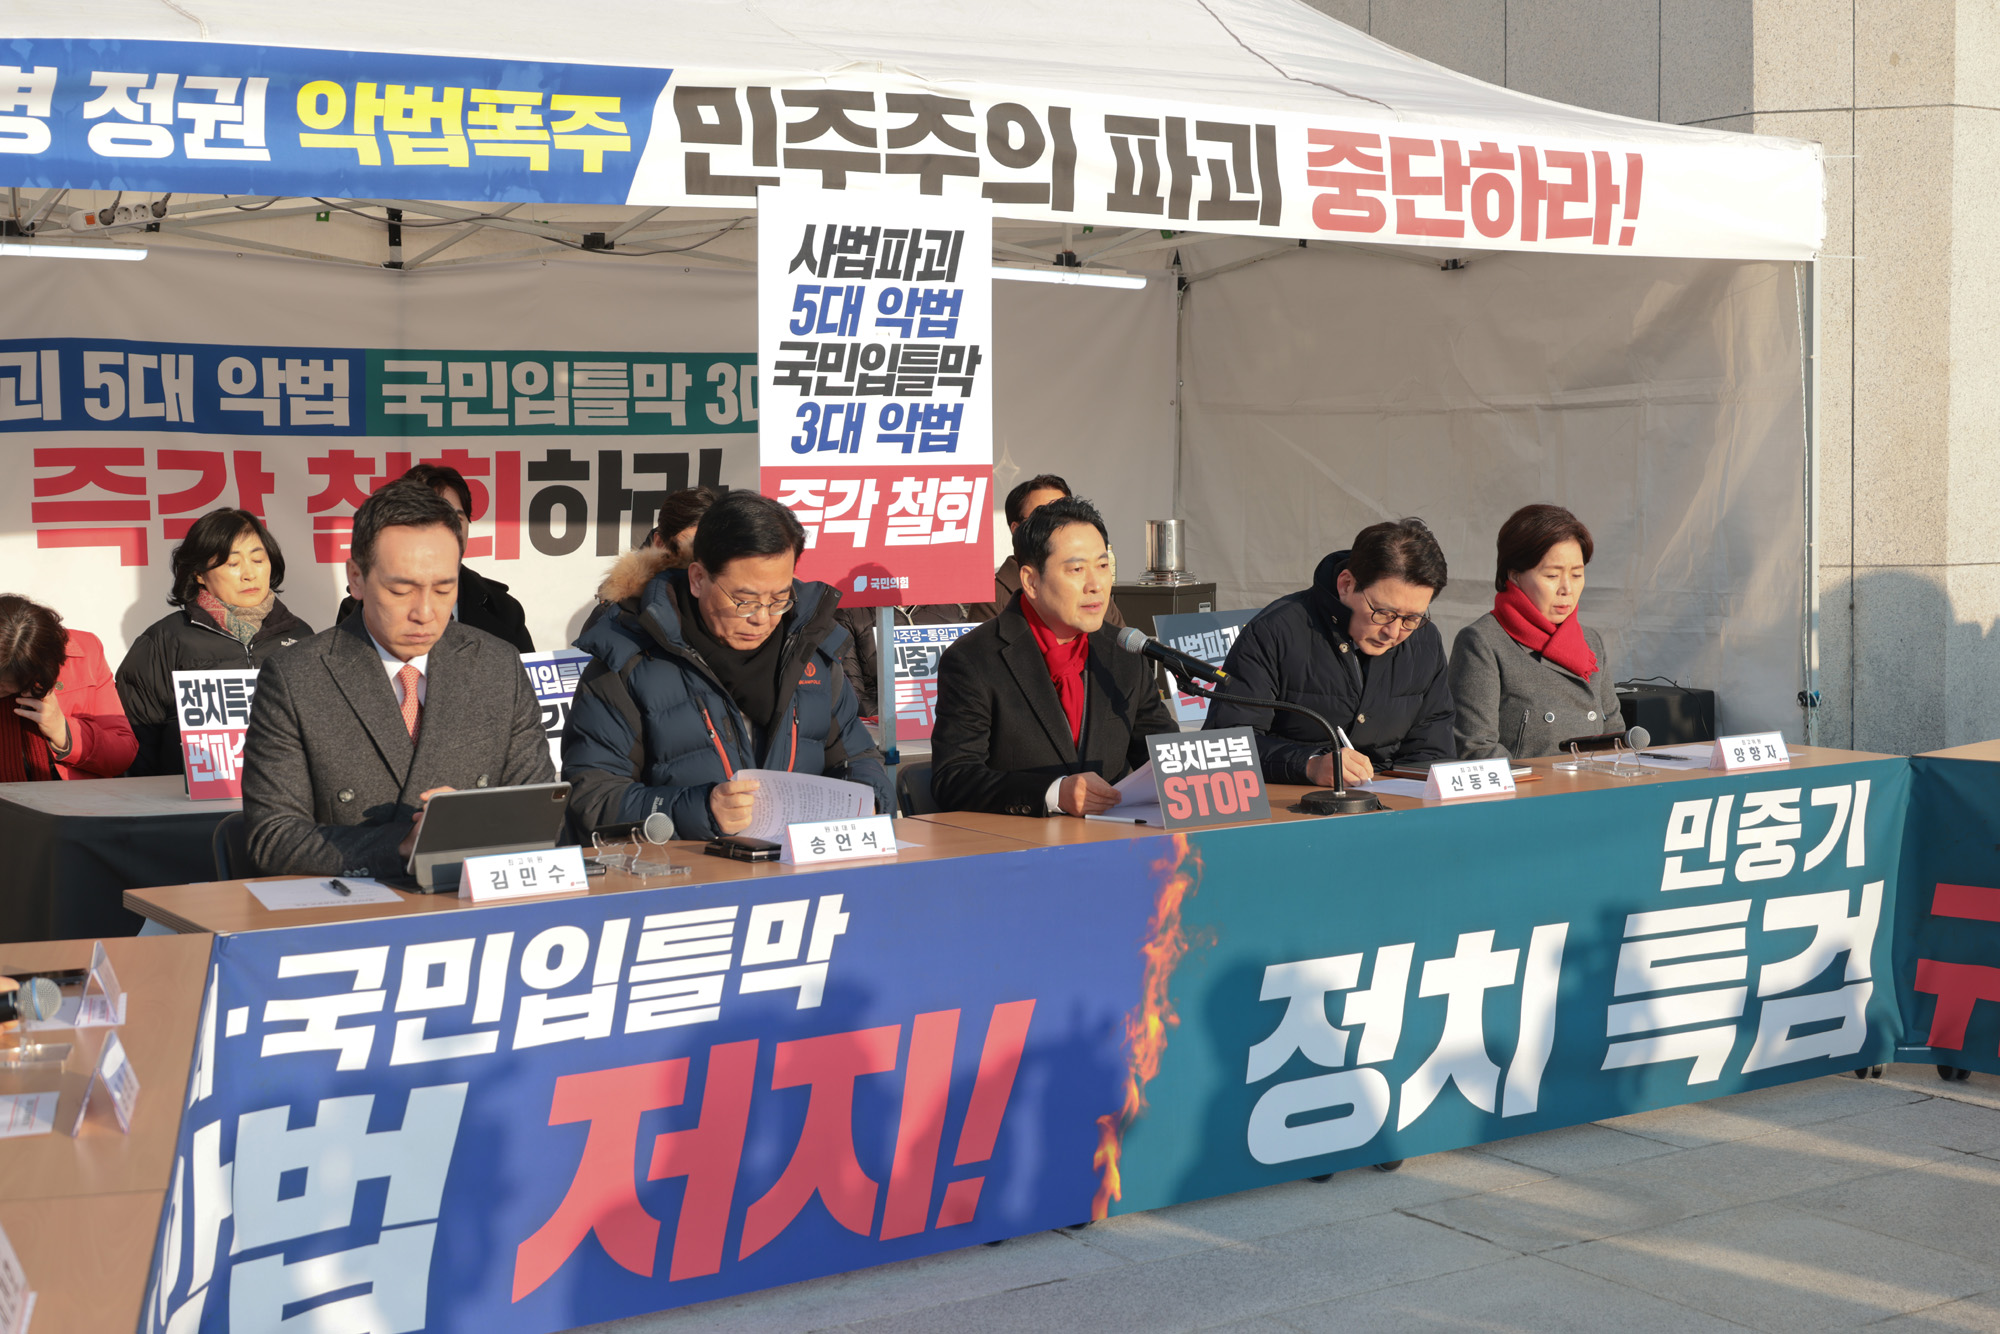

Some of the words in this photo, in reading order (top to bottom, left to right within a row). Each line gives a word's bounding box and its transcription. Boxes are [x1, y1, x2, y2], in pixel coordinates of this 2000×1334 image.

[83, 71, 271, 161] 정권
[296, 80, 631, 173] 악법폭주
[672, 84, 1077, 212] 민주주의
[1104, 113, 1282, 226] 파괴
[1306, 126, 1643, 247] 중단하라!
[788, 223, 965, 283] 사법파괴
[789, 284, 866, 337] 5대
[875, 286, 964, 339] 악법
[83, 350, 195, 423] 5대
[217, 356, 351, 428] 악법
[382, 359, 693, 428] 국민입틀막
[705, 363, 758, 424] 3
[773, 341, 982, 397] 국민입틀막
[791, 401, 867, 454] 3대
[876, 402, 964, 454] 악법
[31, 447, 275, 567] 즉각
[776, 478, 880, 549] 즉각
[884, 475, 988, 547] 철회
[870, 576, 909, 590] 국민의힘
[1155, 735, 1254, 775] 정치보복
[1451, 771, 1501, 792] 신동욱
[1163, 770, 1261, 821] STOP
[810, 831, 877, 854] 송언석
[1660, 780, 1871, 892] 민중기
[490, 864, 566, 890] 김민수
[1246, 922, 1569, 1165] 정치
[1600, 880, 1884, 1086] 특검
[511, 998, 1037, 1305] 저지!
